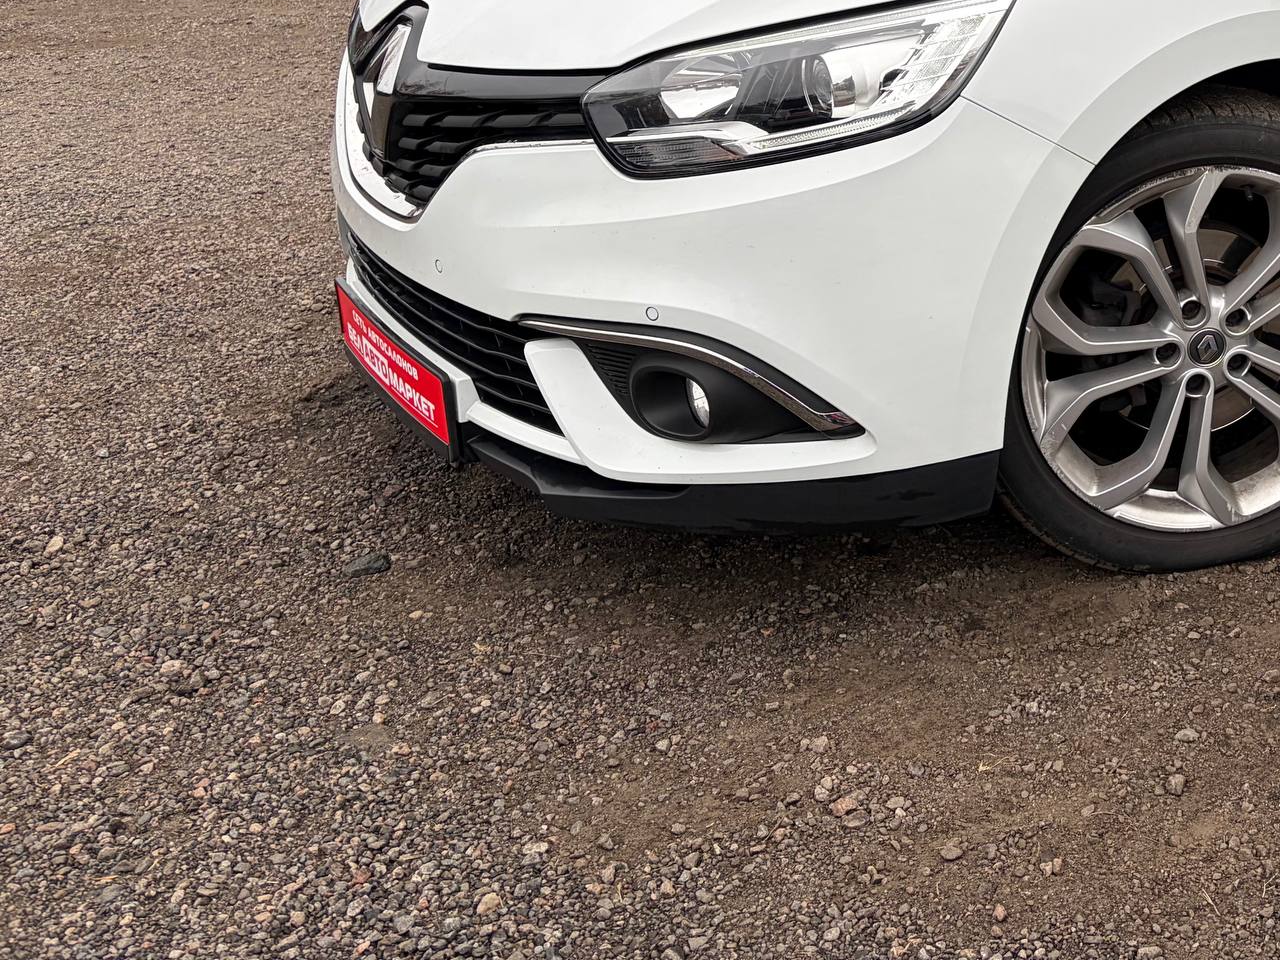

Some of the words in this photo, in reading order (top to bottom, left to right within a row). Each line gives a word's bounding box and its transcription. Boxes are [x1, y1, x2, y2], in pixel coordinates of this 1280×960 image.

[347, 322, 364, 354] БЕЛ
[364, 343, 388, 380] АВТО
[389, 368, 436, 421] МАРКЕТ
[352, 309, 367, 333] СЕТЬ
[368, 327, 419, 381] АВТОСАЛОНОВ
